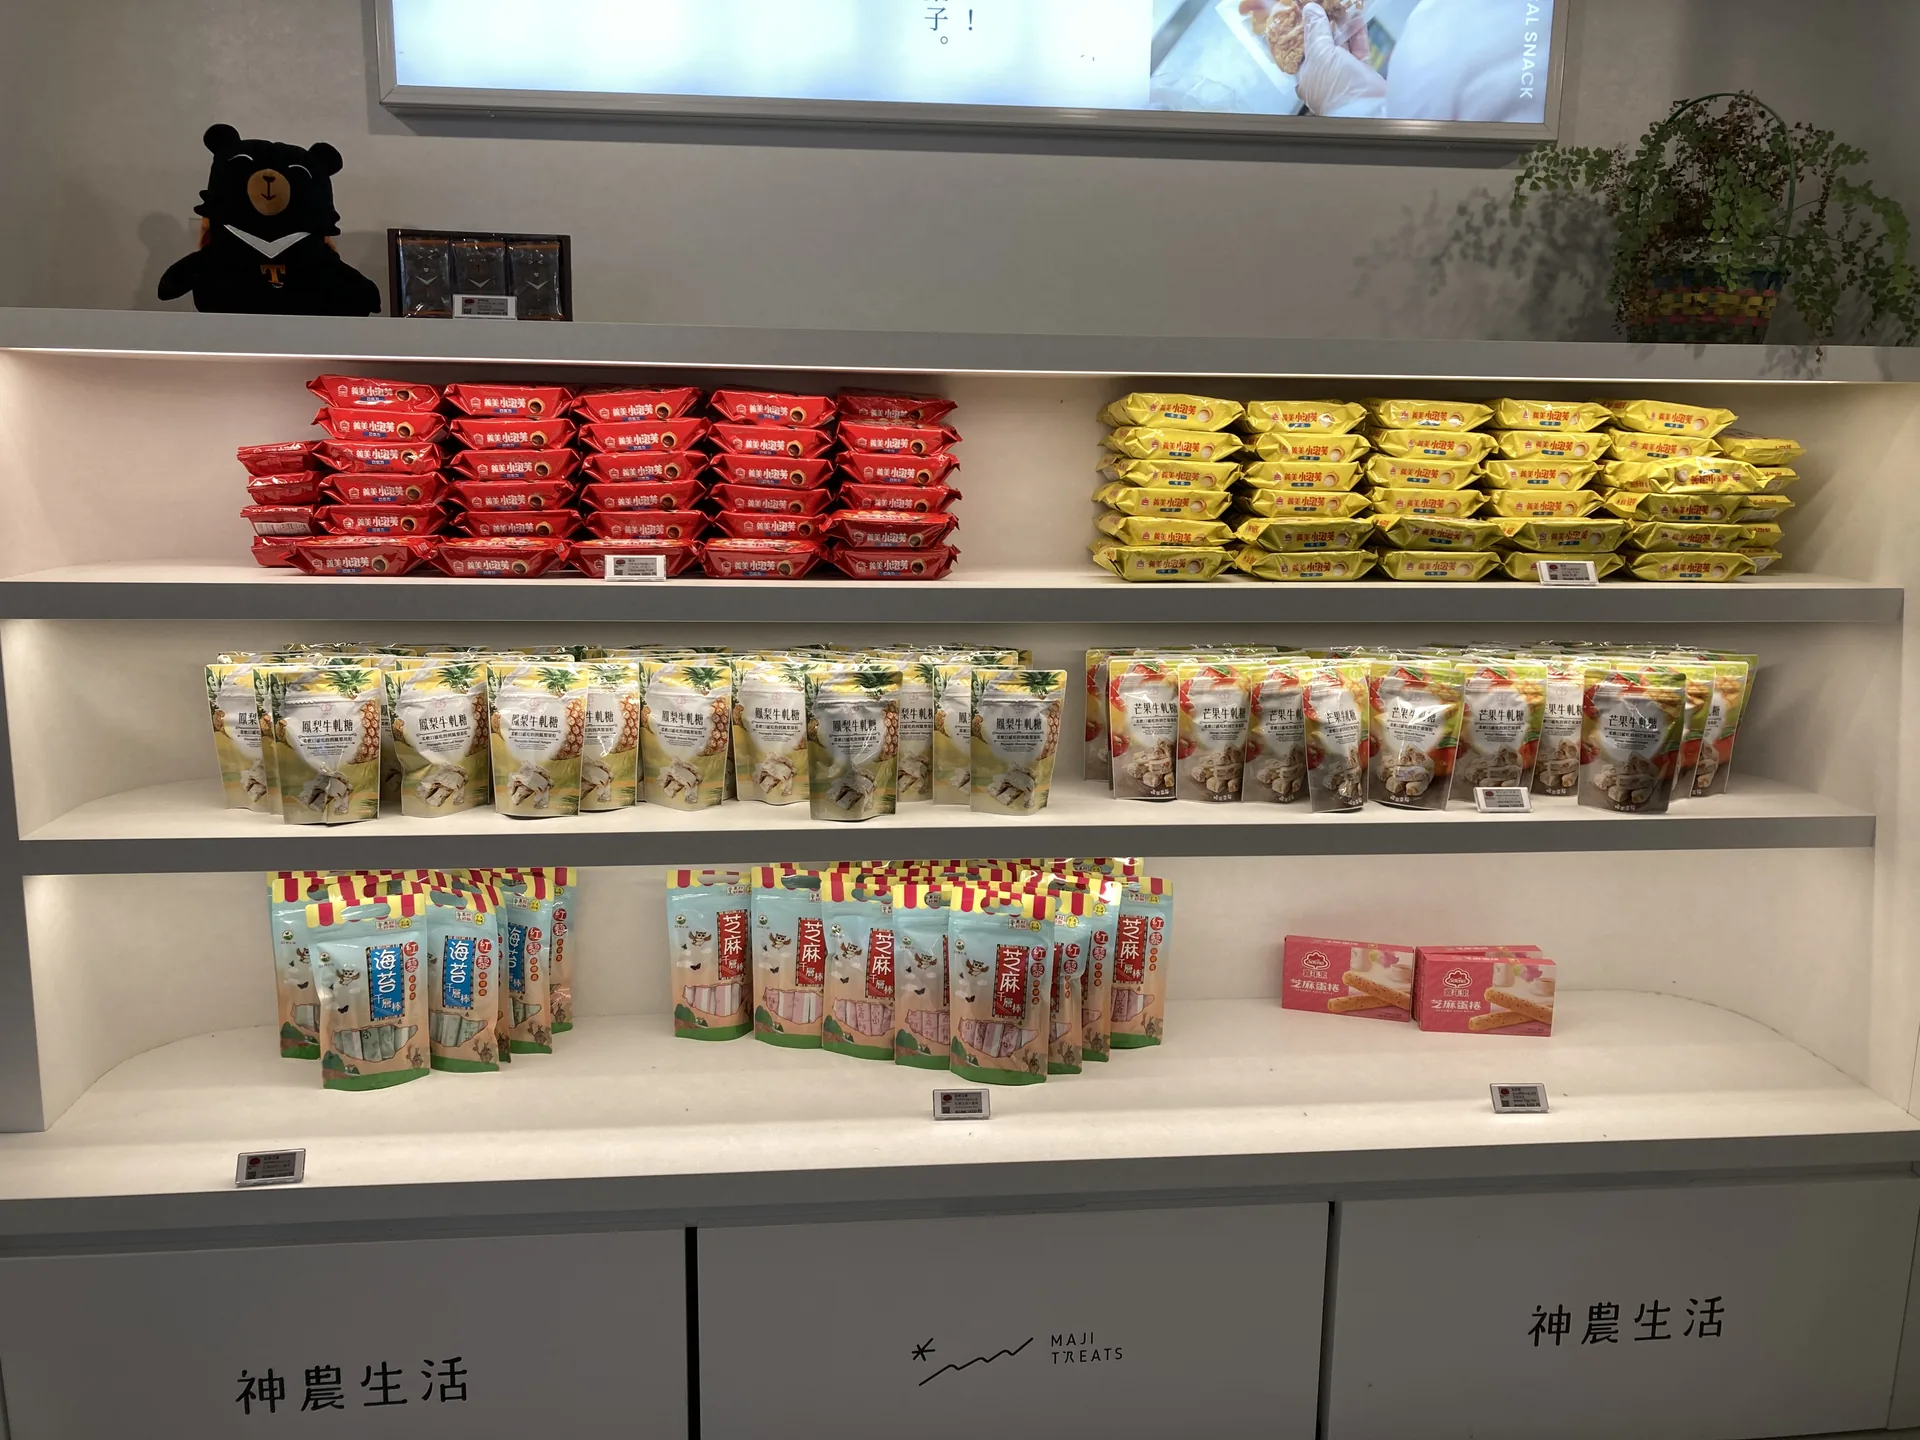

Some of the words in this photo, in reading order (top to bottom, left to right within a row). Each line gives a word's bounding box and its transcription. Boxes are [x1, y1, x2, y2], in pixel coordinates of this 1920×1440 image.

[1520, 31, 1538, 98] SNACK
[260, 264, 286, 288] T
[755, 708, 800, 720] 鳳梨牛軋糖
[1134, 703, 1178, 714] 芒果牛軋糖
[1203, 708, 1246, 720] 芒果牛軋糖
[1478, 709, 1524, 721] 芒果牛軋糖
[302, 719, 354, 732] 鳳梨牛軋糖
[419, 714, 468, 731] 鳳梨牛軋糖
[512, 714, 558, 728] 鳳梨牛軋糖
[662, 710, 704, 726] 鳳梨牛軋糖
[832, 719, 876, 732] 鳳梨牛軋糖
[996, 718, 1042, 730] 鳳梨牛軋糖
[723, 914, 742, 954] 芝麻
[802, 922, 822, 962] 芝麻
[1120, 918, 1142, 960] 芝麻
[874, 932, 894, 975] 芝麻
[450, 940, 470, 984] 海苔
[374, 949, 396, 992] 海苔
[1000, 949, 1022, 993] 芝麻
[1290, 979, 1340, 992] 芝麻蛋捲
[1431, 1000, 1481, 1010] 芝麻蛋捲
[1528, 1296, 1725, 1347] 神農生活
[1051, 1332, 1094, 1347] MAJI
[1052, 1348, 1123, 1364] TREATS
[235, 1356, 468, 1415] 神農生活
